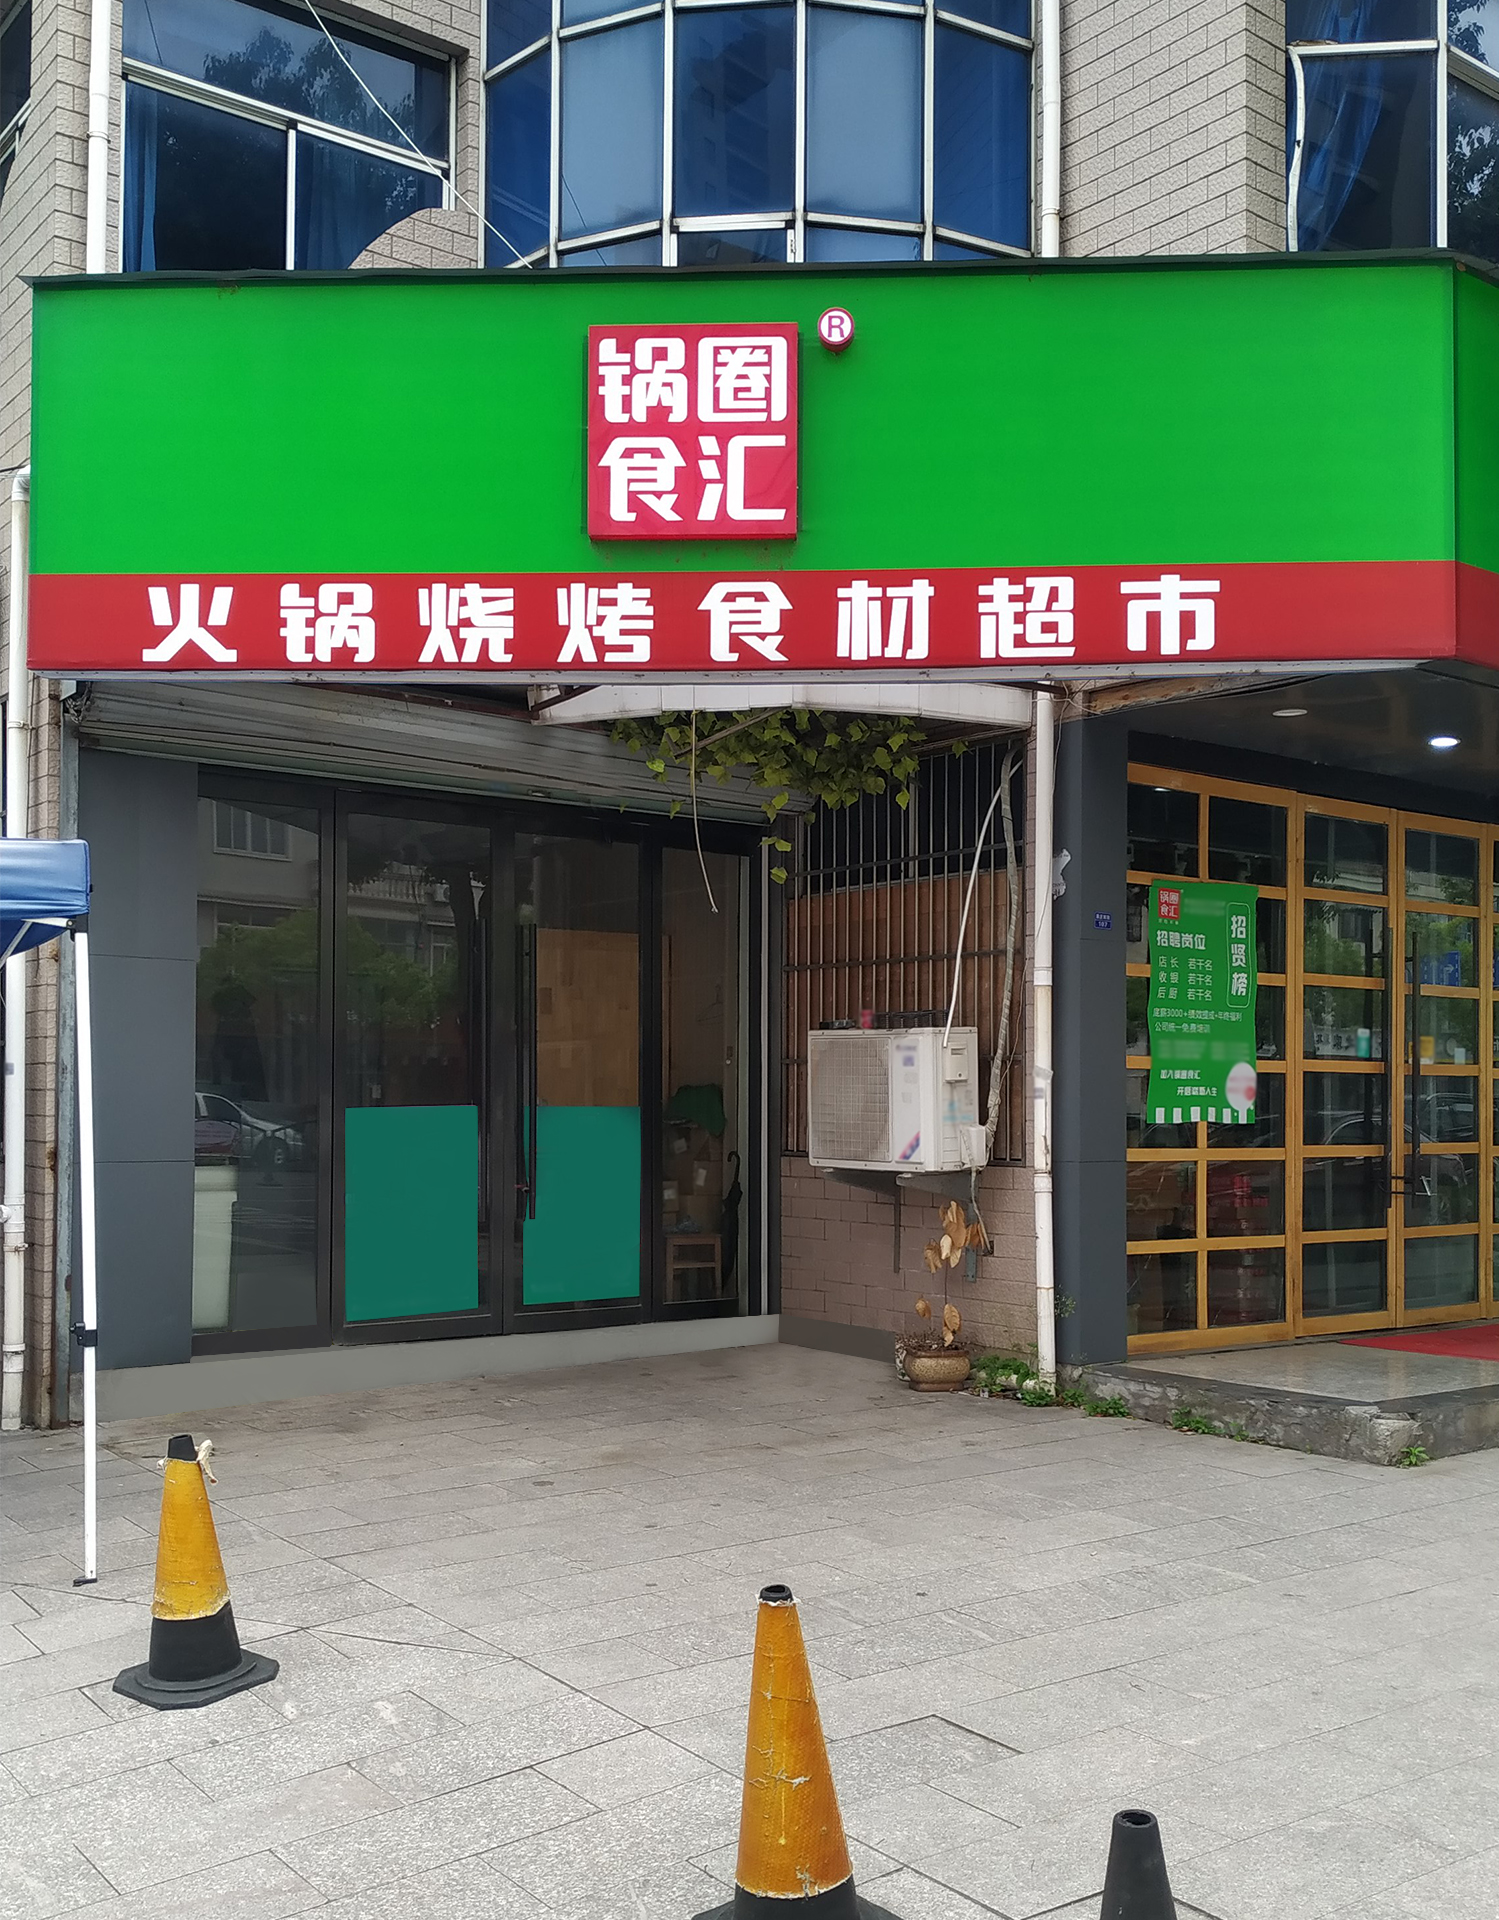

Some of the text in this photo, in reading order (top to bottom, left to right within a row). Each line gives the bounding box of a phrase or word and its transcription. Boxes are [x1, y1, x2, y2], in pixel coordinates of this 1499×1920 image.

[598, 336, 788, 423] 锅圈
[597, 435, 786, 522] 食汇
[142, 574, 1221, 664] 火锅烧烤食材超市
[1160, 904, 1179, 918] 食汇
[1156, 929, 1206, 950] 招聘岗位
[1158, 955, 1213, 971] 店长 若干名
[1230, 914, 1248, 996] 招贤榜
[1187, 972, 1213, 986] 若干名
[1186, 988, 1212, 1002] 若干名
